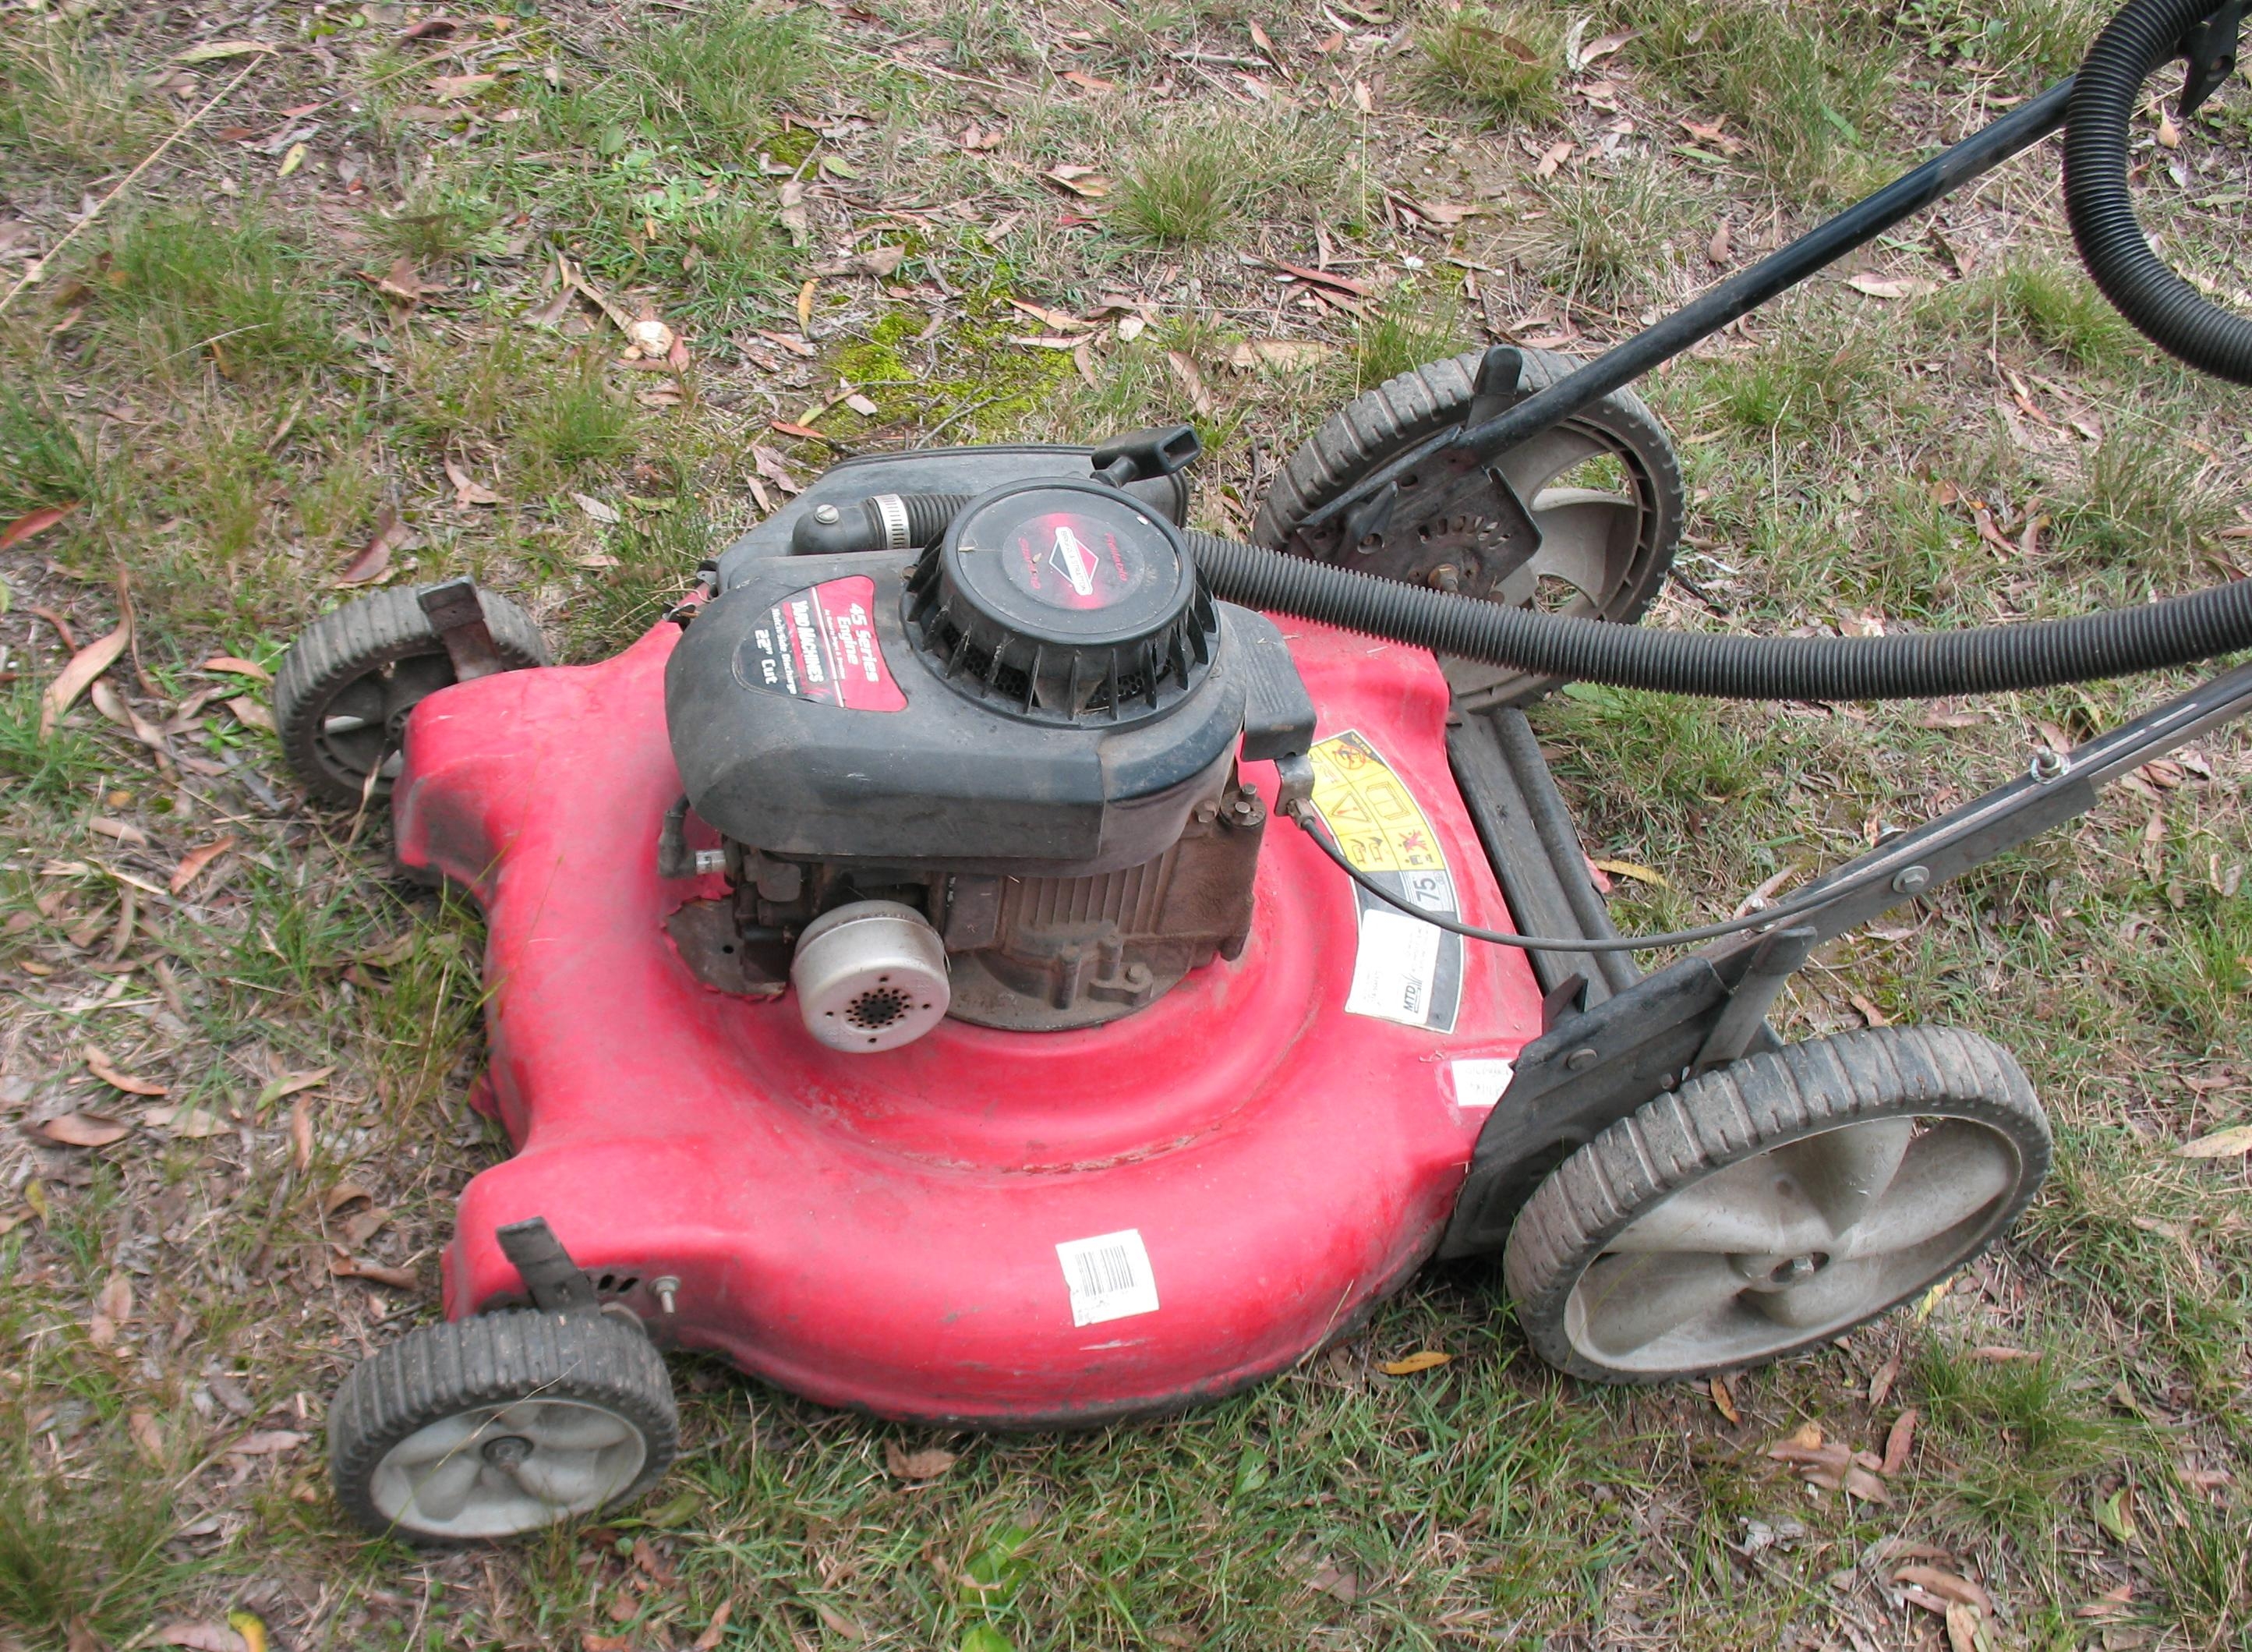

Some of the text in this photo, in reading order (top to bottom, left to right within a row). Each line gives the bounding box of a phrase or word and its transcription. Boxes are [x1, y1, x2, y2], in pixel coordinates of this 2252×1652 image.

[755, 628, 778, 685] 22" Cut
[792, 600, 824, 683] YARD MACHINES
[837, 616, 859, 665] Engine
[850, 603, 879, 682] 45 Series
[781, 653, 797, 695] Discharge
[1412, 877, 1440, 902] 75
[1403, 985, 1416, 1011] MTD
